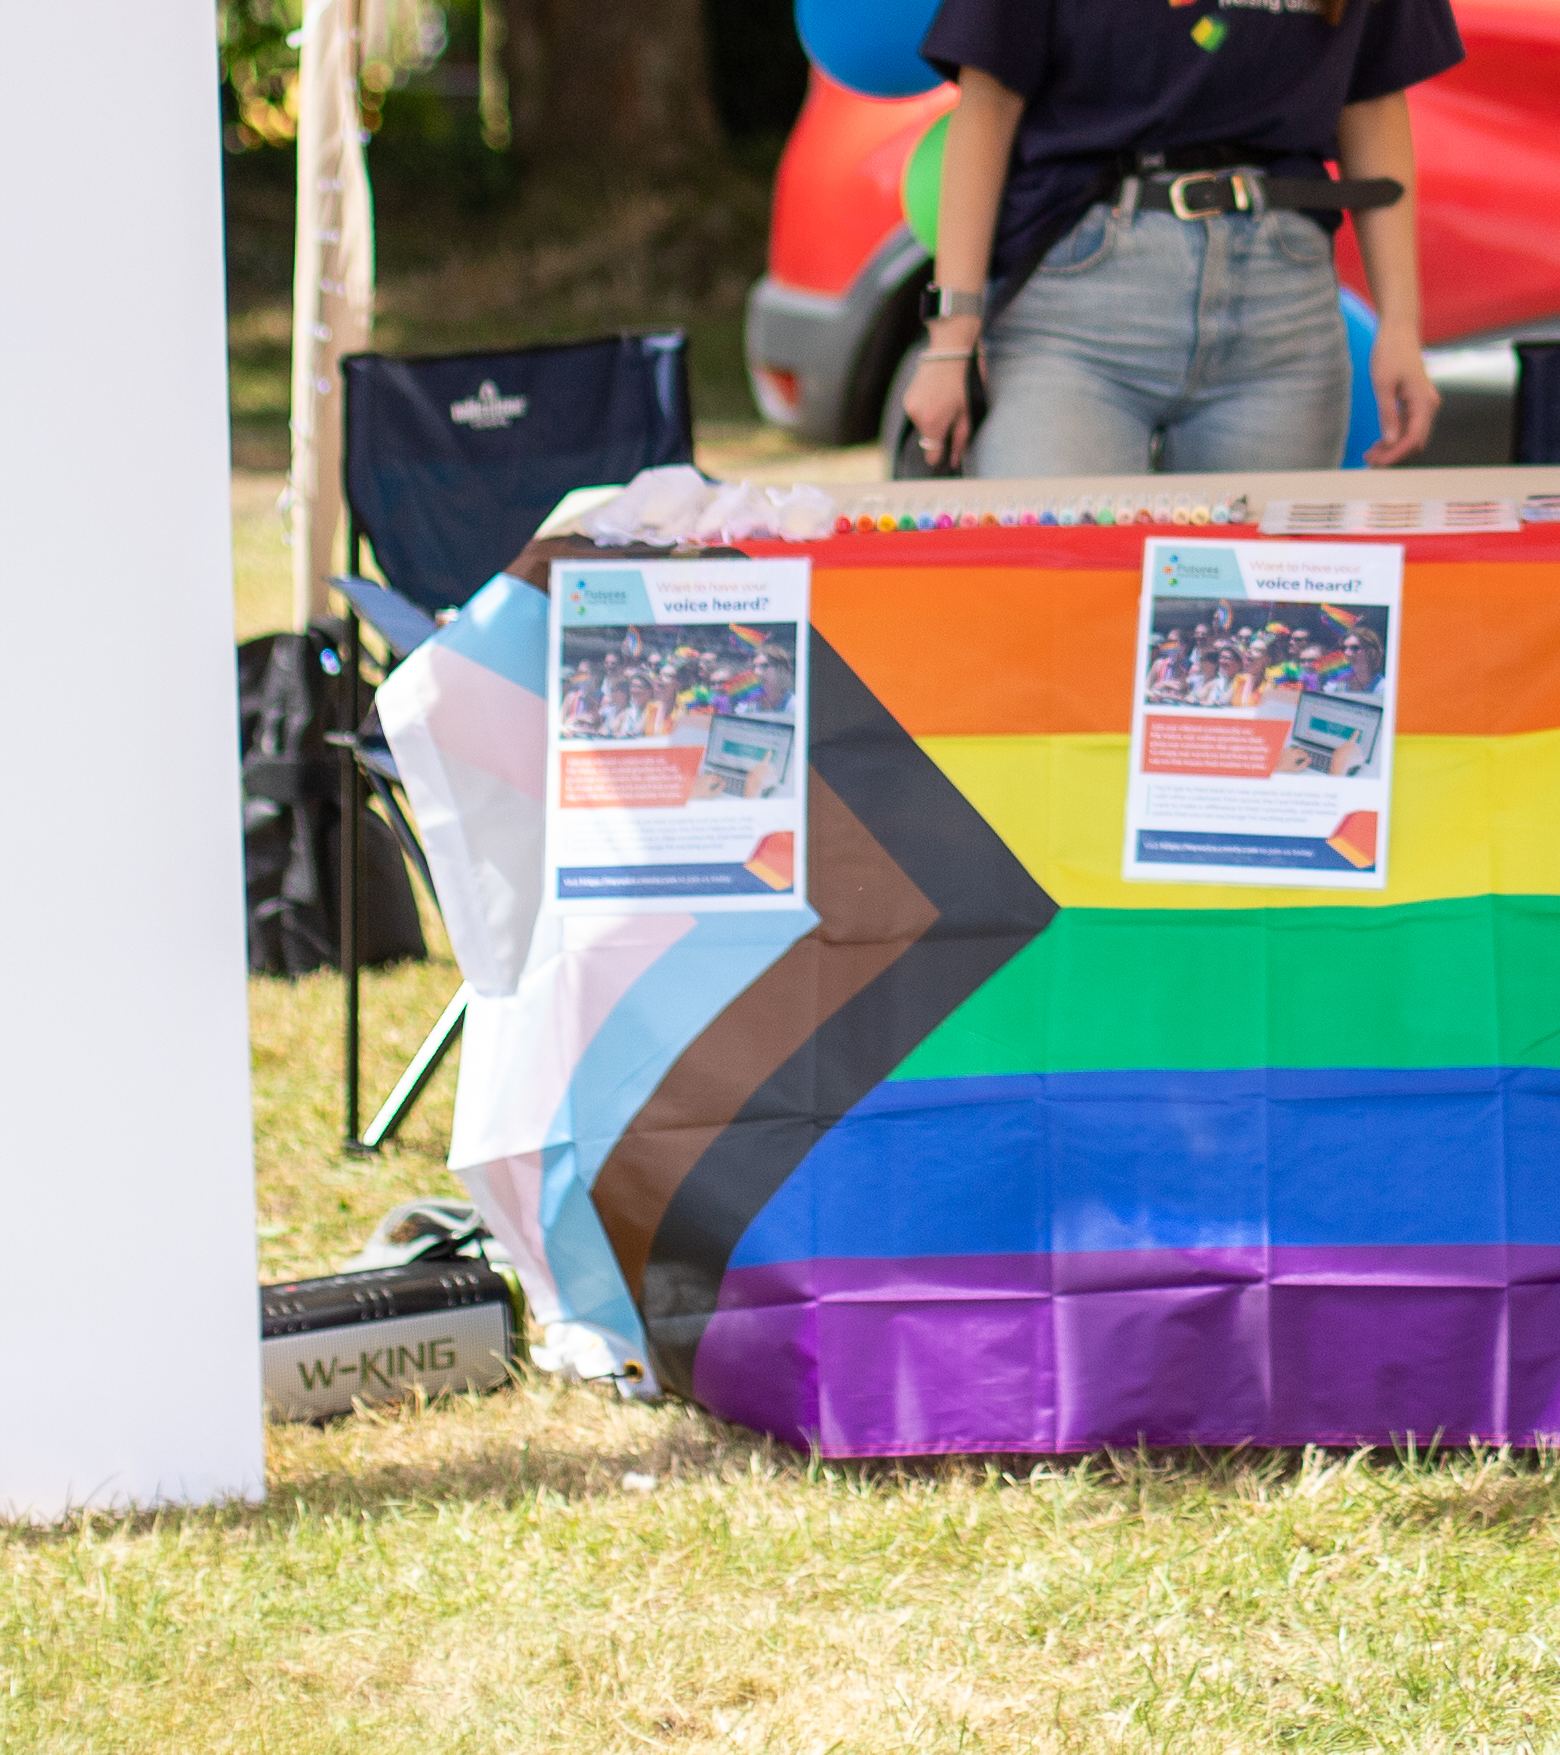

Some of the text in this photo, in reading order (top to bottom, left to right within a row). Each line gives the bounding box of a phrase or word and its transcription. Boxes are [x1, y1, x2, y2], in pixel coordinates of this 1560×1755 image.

[1256, 577, 1362, 592] voice heard?
[664, 597, 769, 612] voice heard?
[297, 1337, 457, 1391] W-KING
